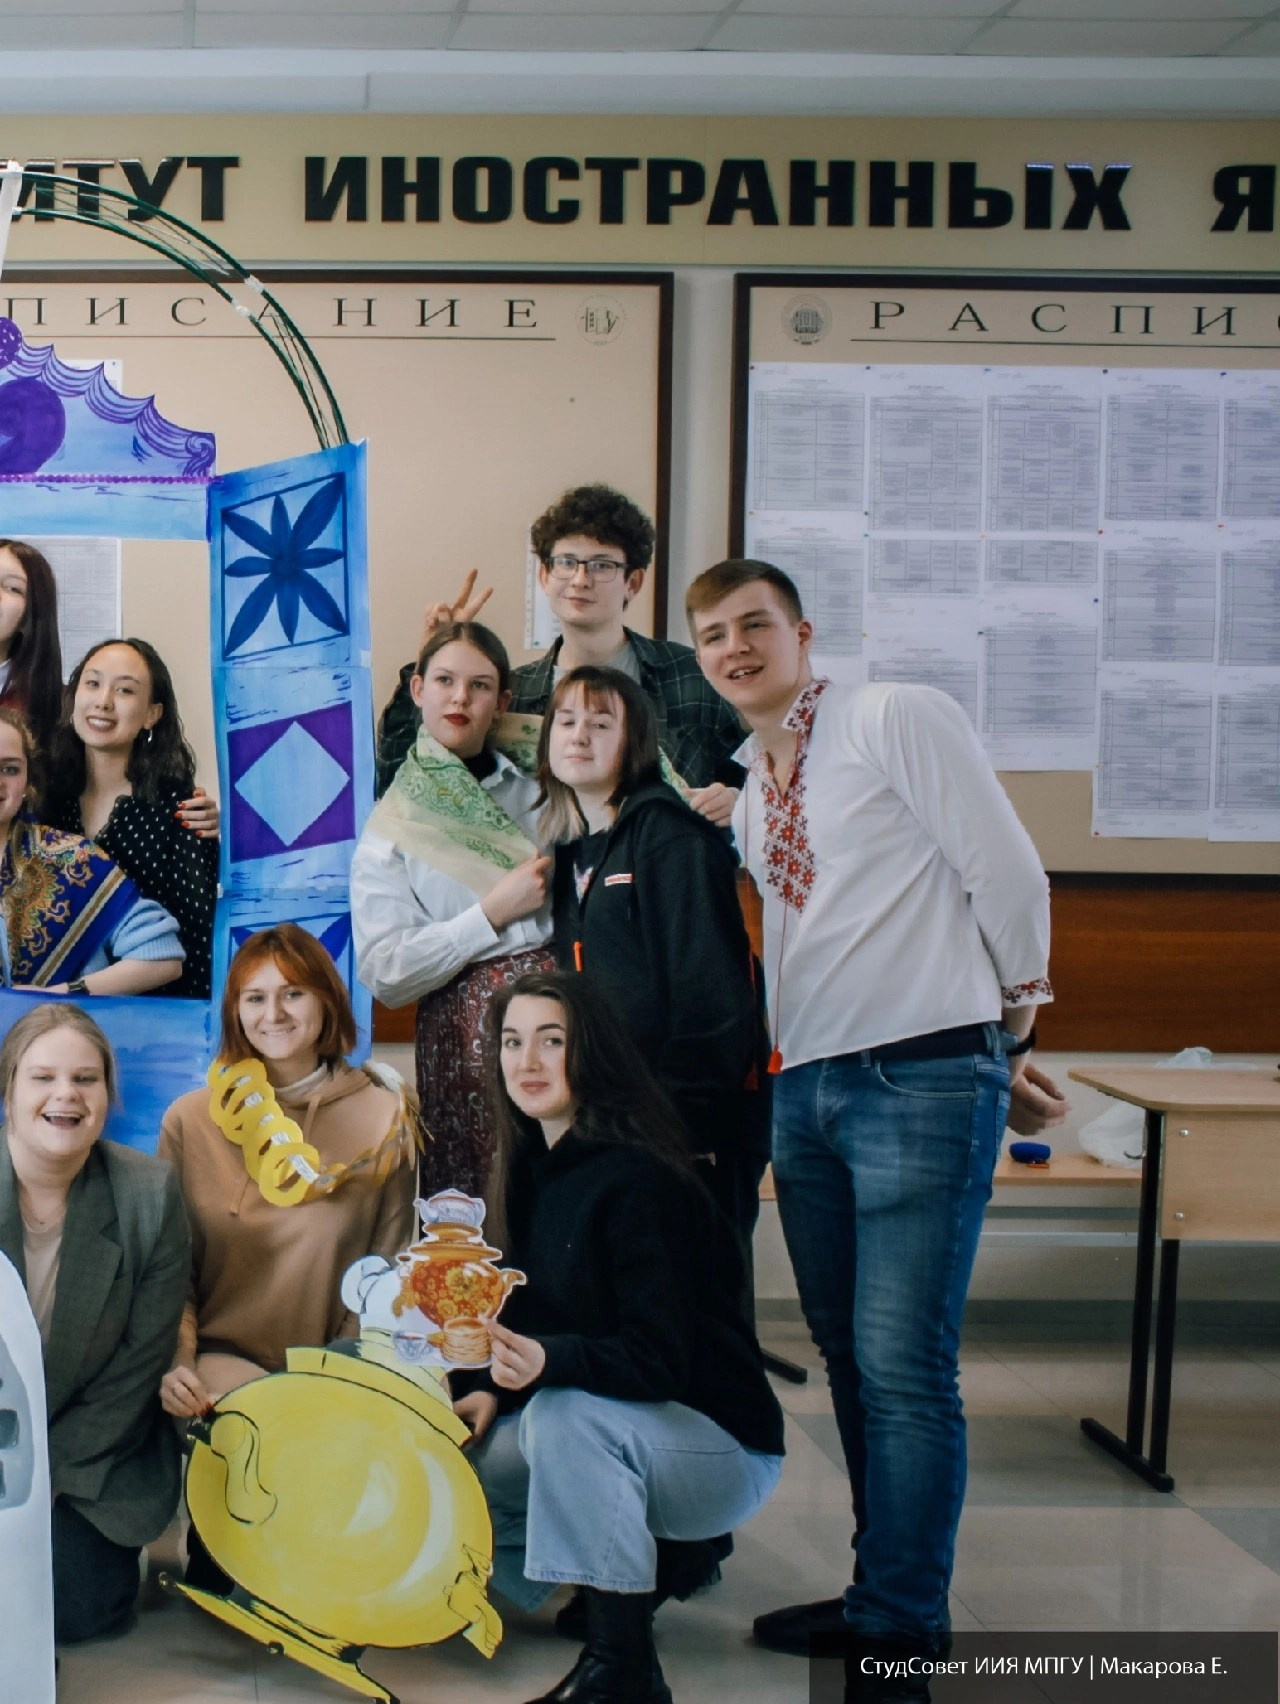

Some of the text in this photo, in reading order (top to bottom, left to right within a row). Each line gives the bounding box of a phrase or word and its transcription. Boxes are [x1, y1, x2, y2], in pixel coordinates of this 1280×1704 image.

[304, 156, 1133, 231] ИНОСТРАННЫХ
[1210, 164, 1277, 232] Я
[869, 301, 1280, 336] РАСПИ
